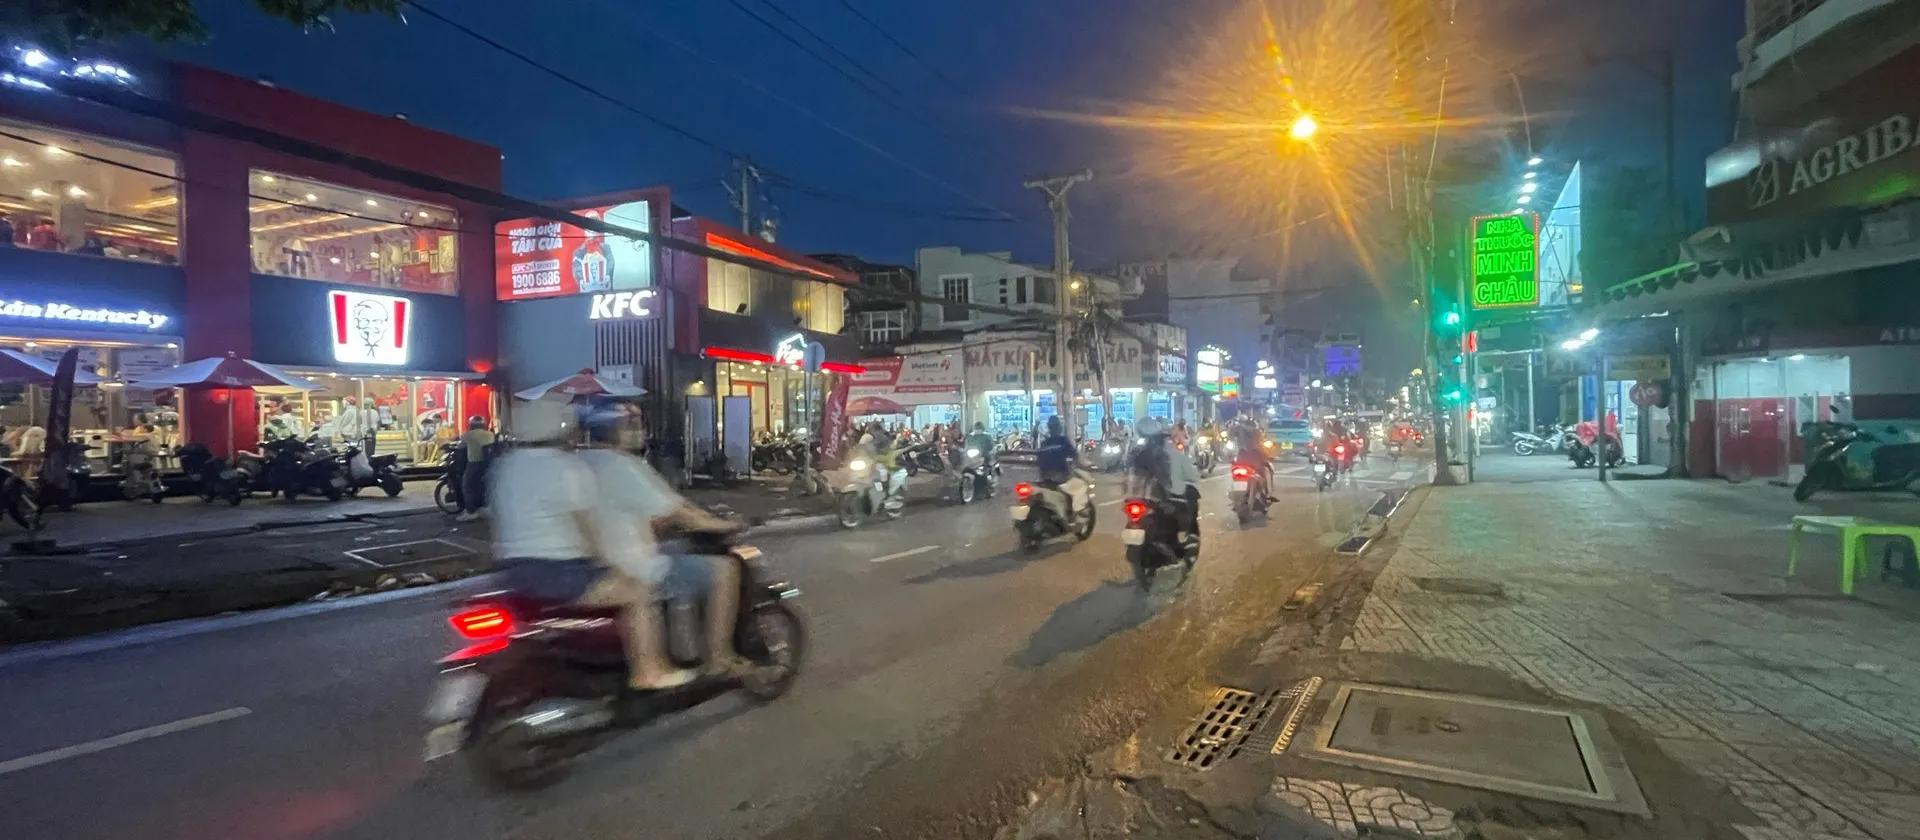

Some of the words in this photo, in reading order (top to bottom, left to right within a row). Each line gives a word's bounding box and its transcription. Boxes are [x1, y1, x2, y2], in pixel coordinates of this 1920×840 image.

[1788, 113, 1920, 195] AGRIB
[1486, 216, 1523, 234] NHÀ
[512, 236, 535, 256] TẬN
[1473, 230, 1534, 251] THUỐC
[1476, 250, 1533, 275] MINH
[512, 274, 534, 288] 1900
[536, 271, 560, 286] 6886
[590, 290, 653, 319] KFC
[45, 303, 168, 329] Kentucky
[1103, 343, 1138, 364] HÁP
